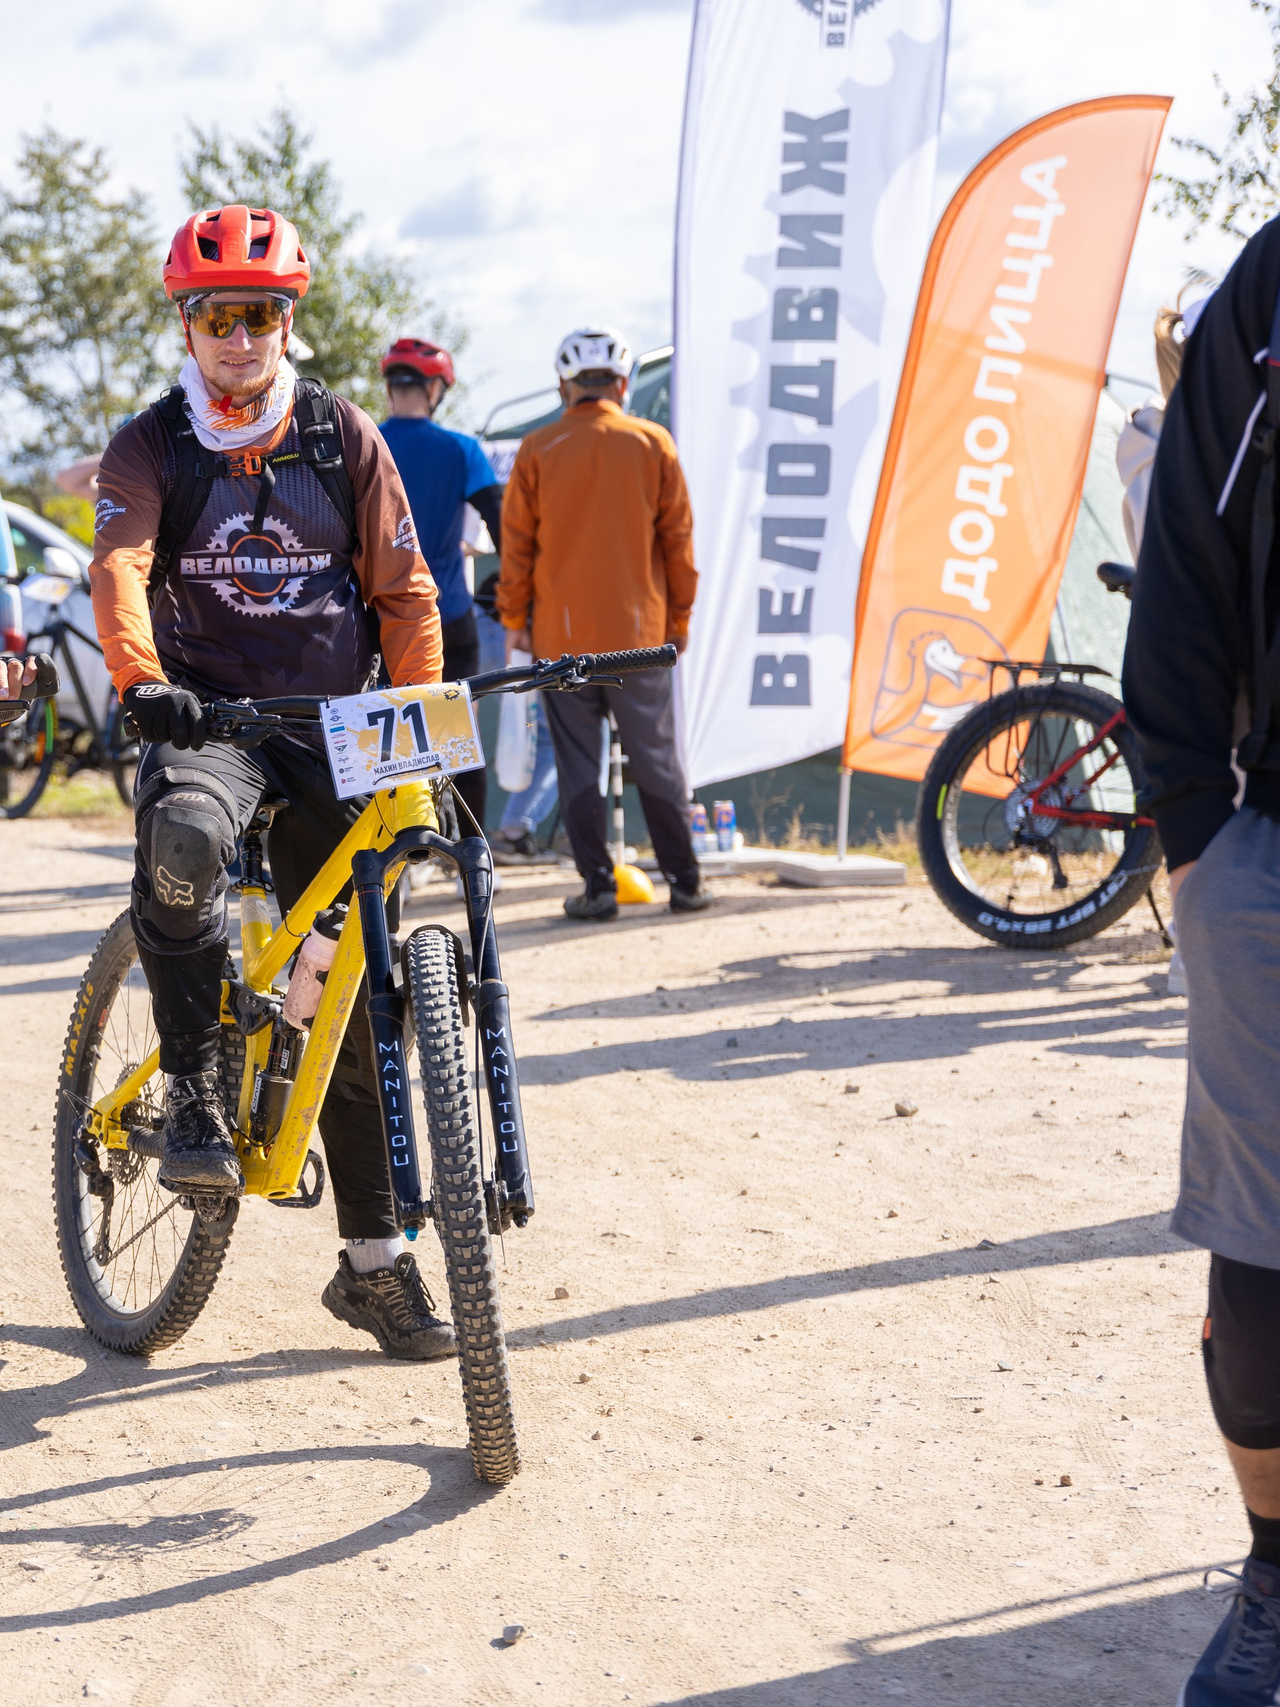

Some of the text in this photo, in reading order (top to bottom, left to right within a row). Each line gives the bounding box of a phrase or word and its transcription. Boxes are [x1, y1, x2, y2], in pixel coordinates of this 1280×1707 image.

[749, 108, 851, 706] ВЕЛОДВИЖ
[940, 154, 1068, 612] ДОДО ПИЦЦА
[180, 552, 332, 576] ВЕЛОДВИЖ
[367, 702, 430, 763] 71
[374, 753, 441, 776] МАХИН ВЛАДИСЛАВ
[173, 792, 207, 803] FOX
[64, 981, 94, 1077] MAXXIS
[378, 1040, 410, 1167] MANITOU
[486, 1026, 519, 1153] MANITOU
